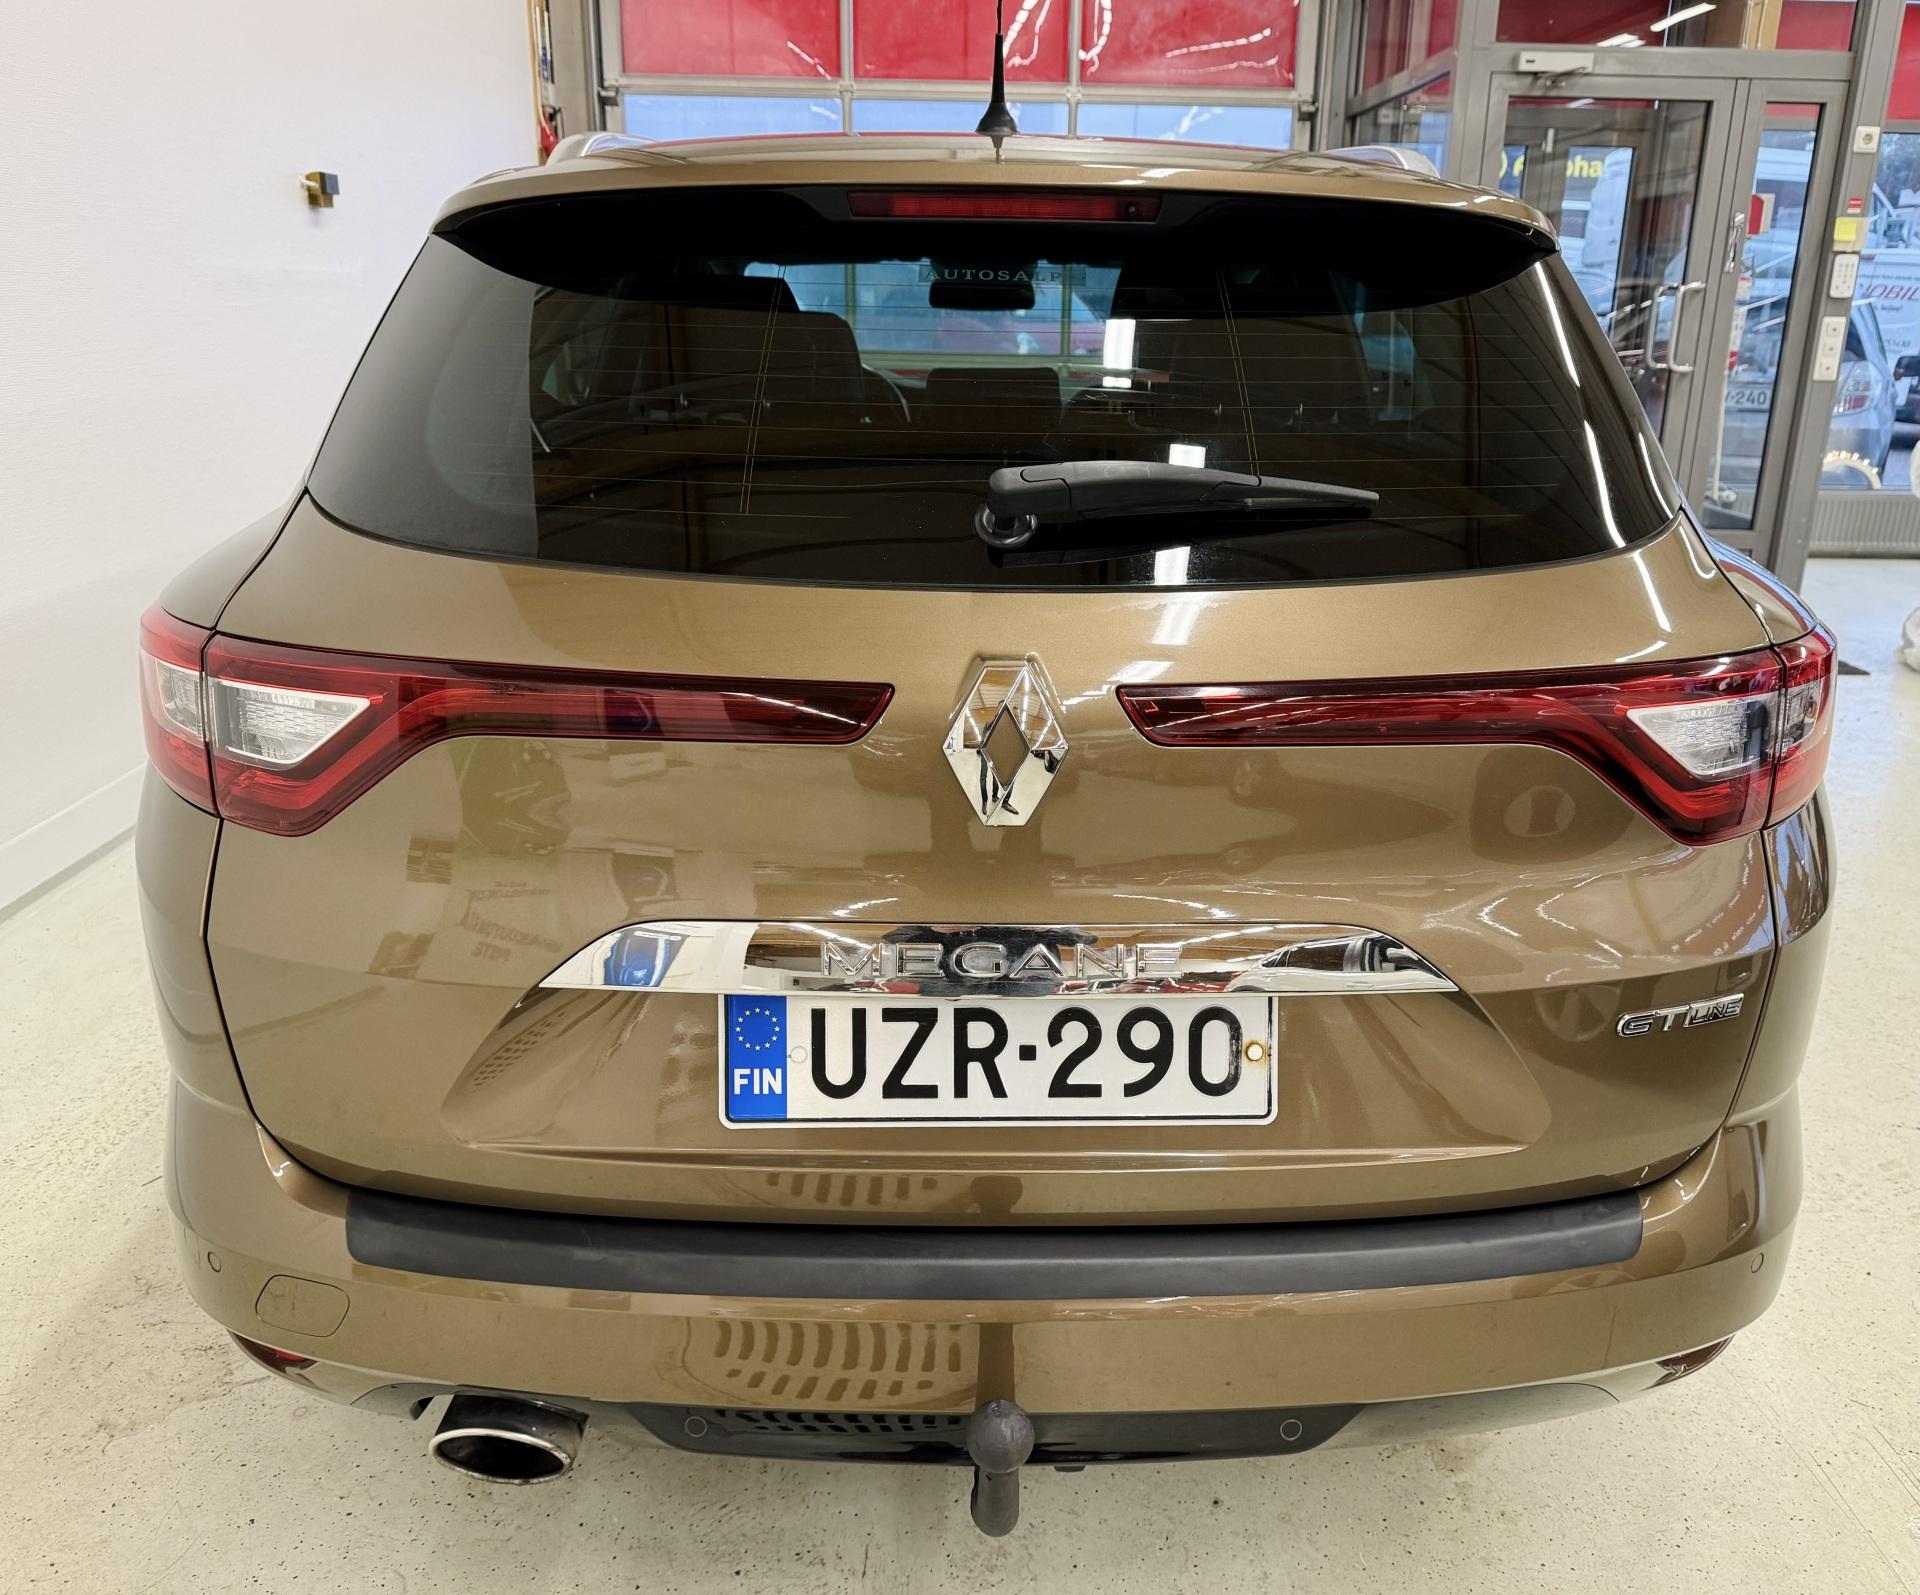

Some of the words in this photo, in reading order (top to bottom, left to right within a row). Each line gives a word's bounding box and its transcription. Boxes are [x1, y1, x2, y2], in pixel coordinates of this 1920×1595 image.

[927, 268, 1064, 282] AUTOSALP
[820, 942, 1183, 979] MEGANE
[810, 1006, 1242, 1100] UZR-290
[734, 1067, 783, 1096] FIN
